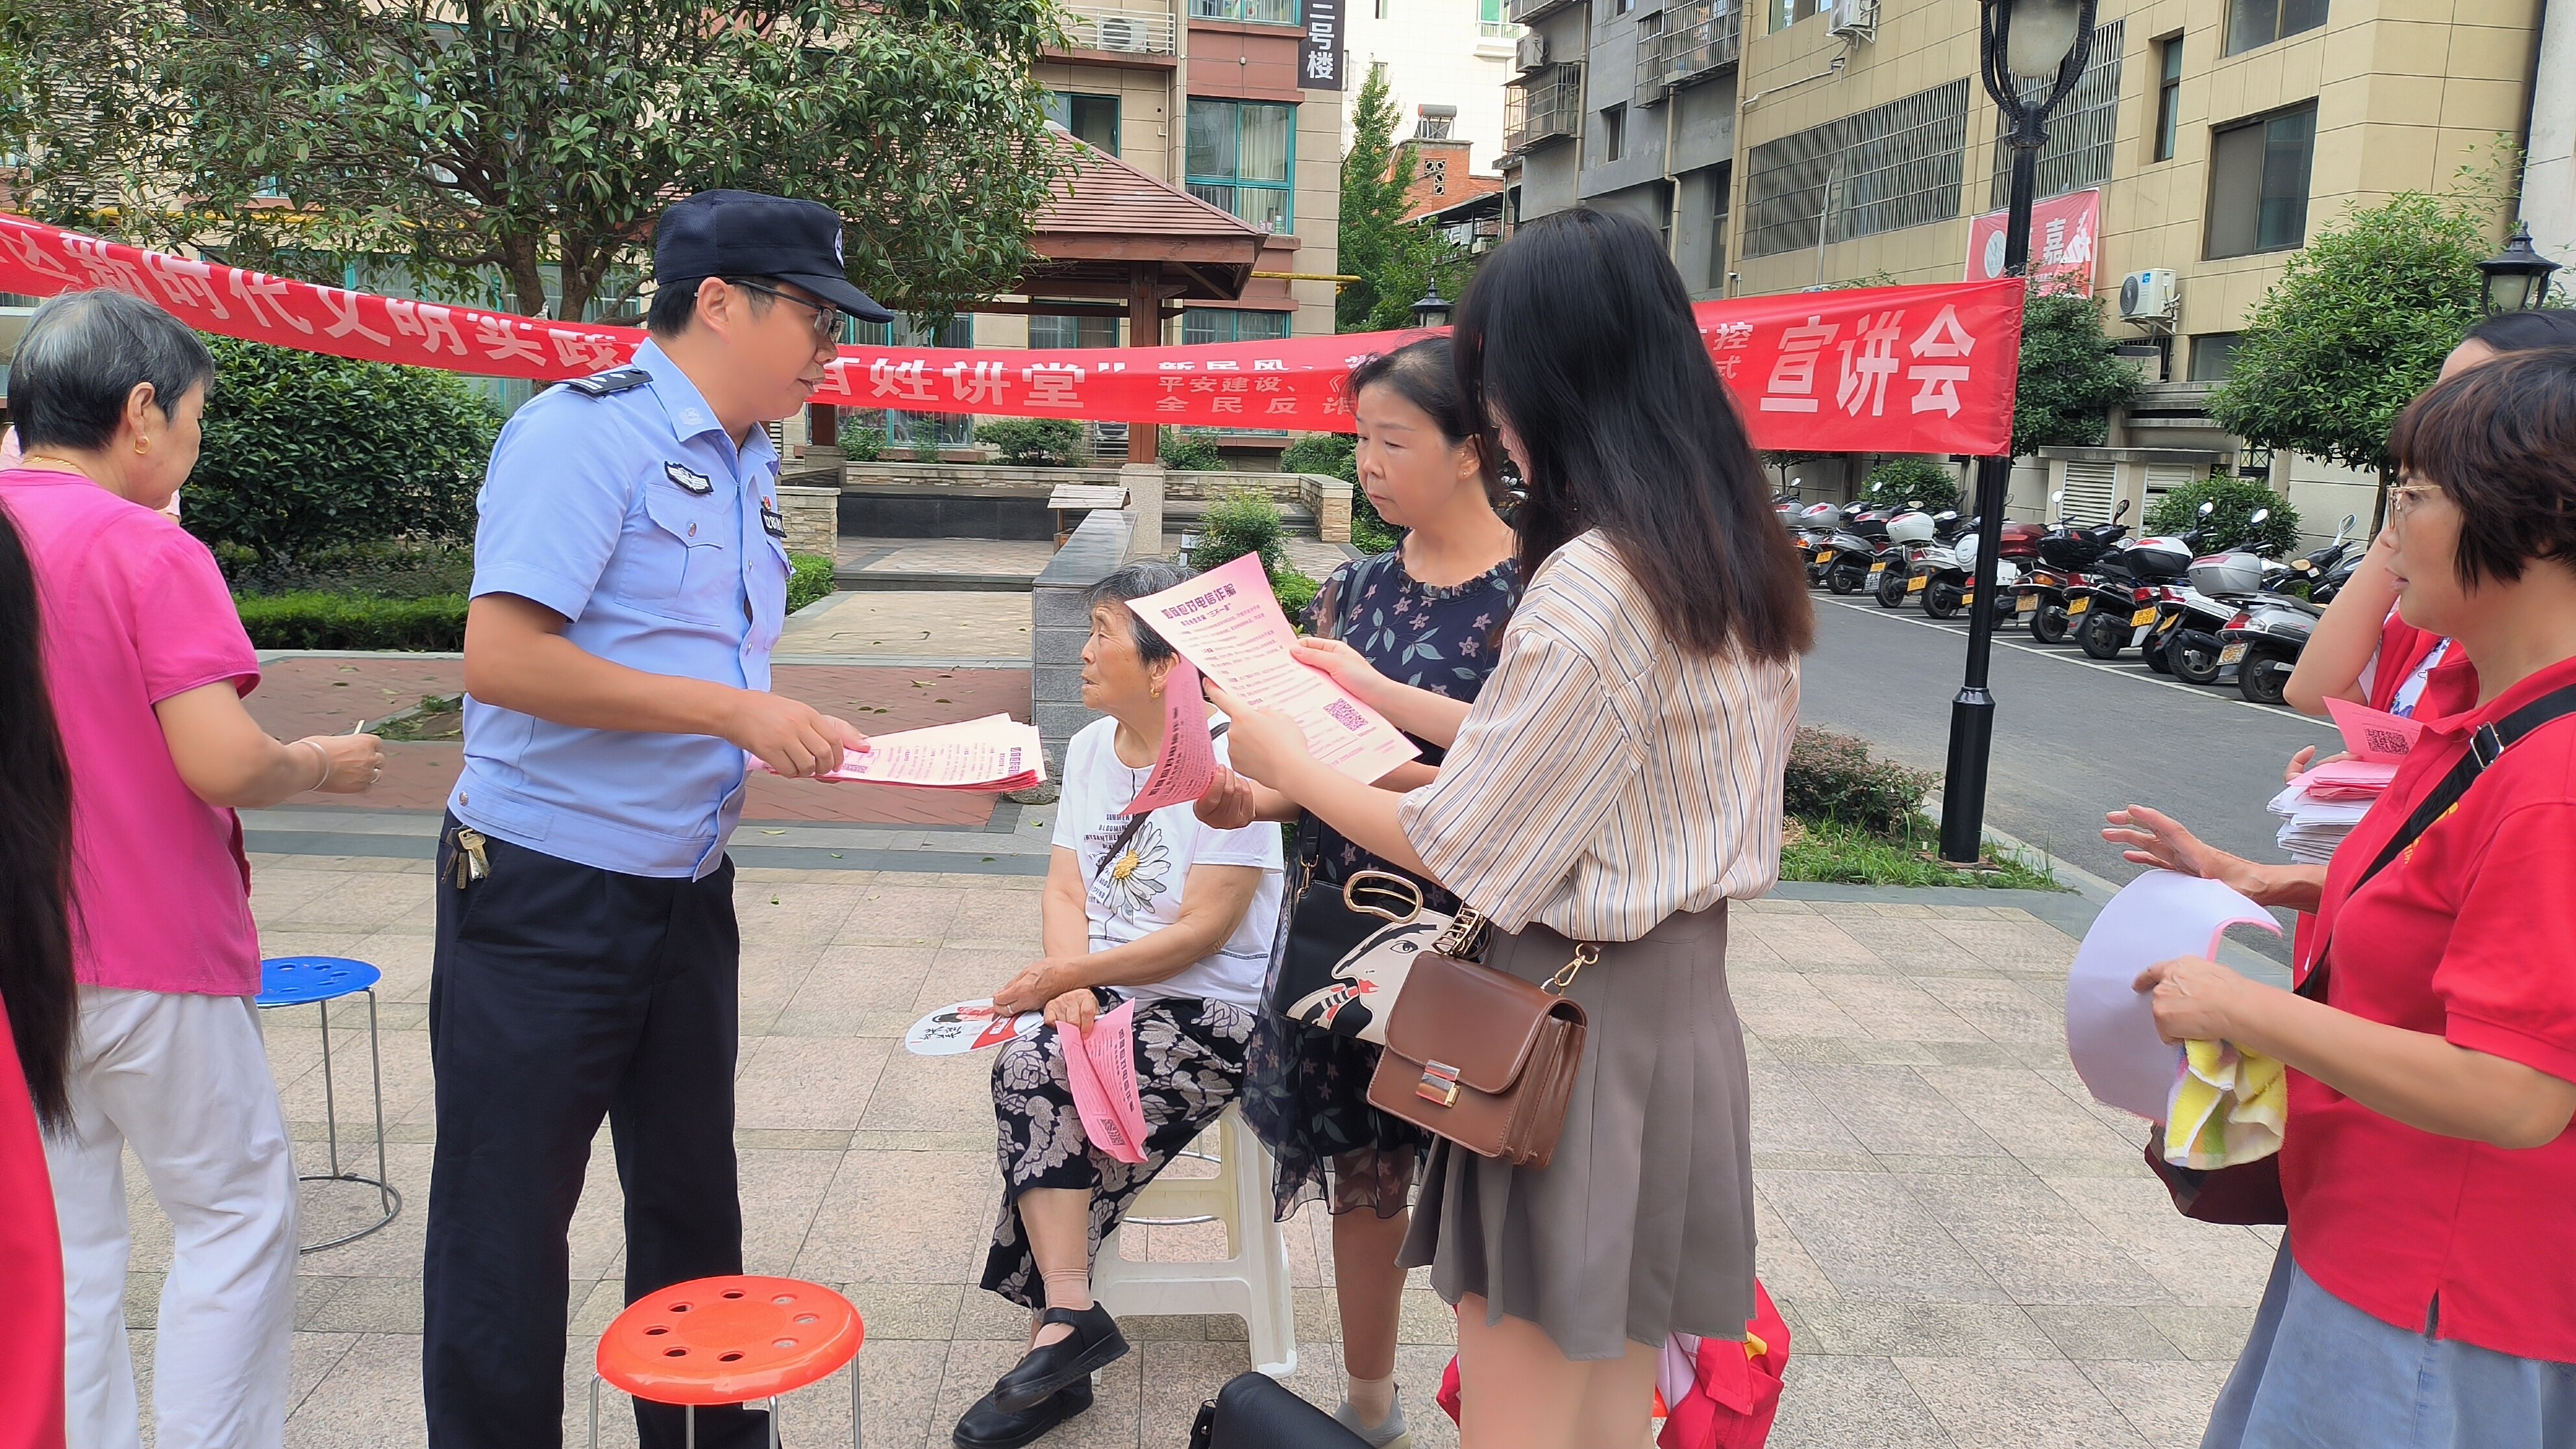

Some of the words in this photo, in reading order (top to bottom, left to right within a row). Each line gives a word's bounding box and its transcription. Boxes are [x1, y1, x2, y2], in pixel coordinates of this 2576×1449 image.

[1699, 321, 1753, 351] 控
[1760, 304, 1976, 419] 宣讲会
